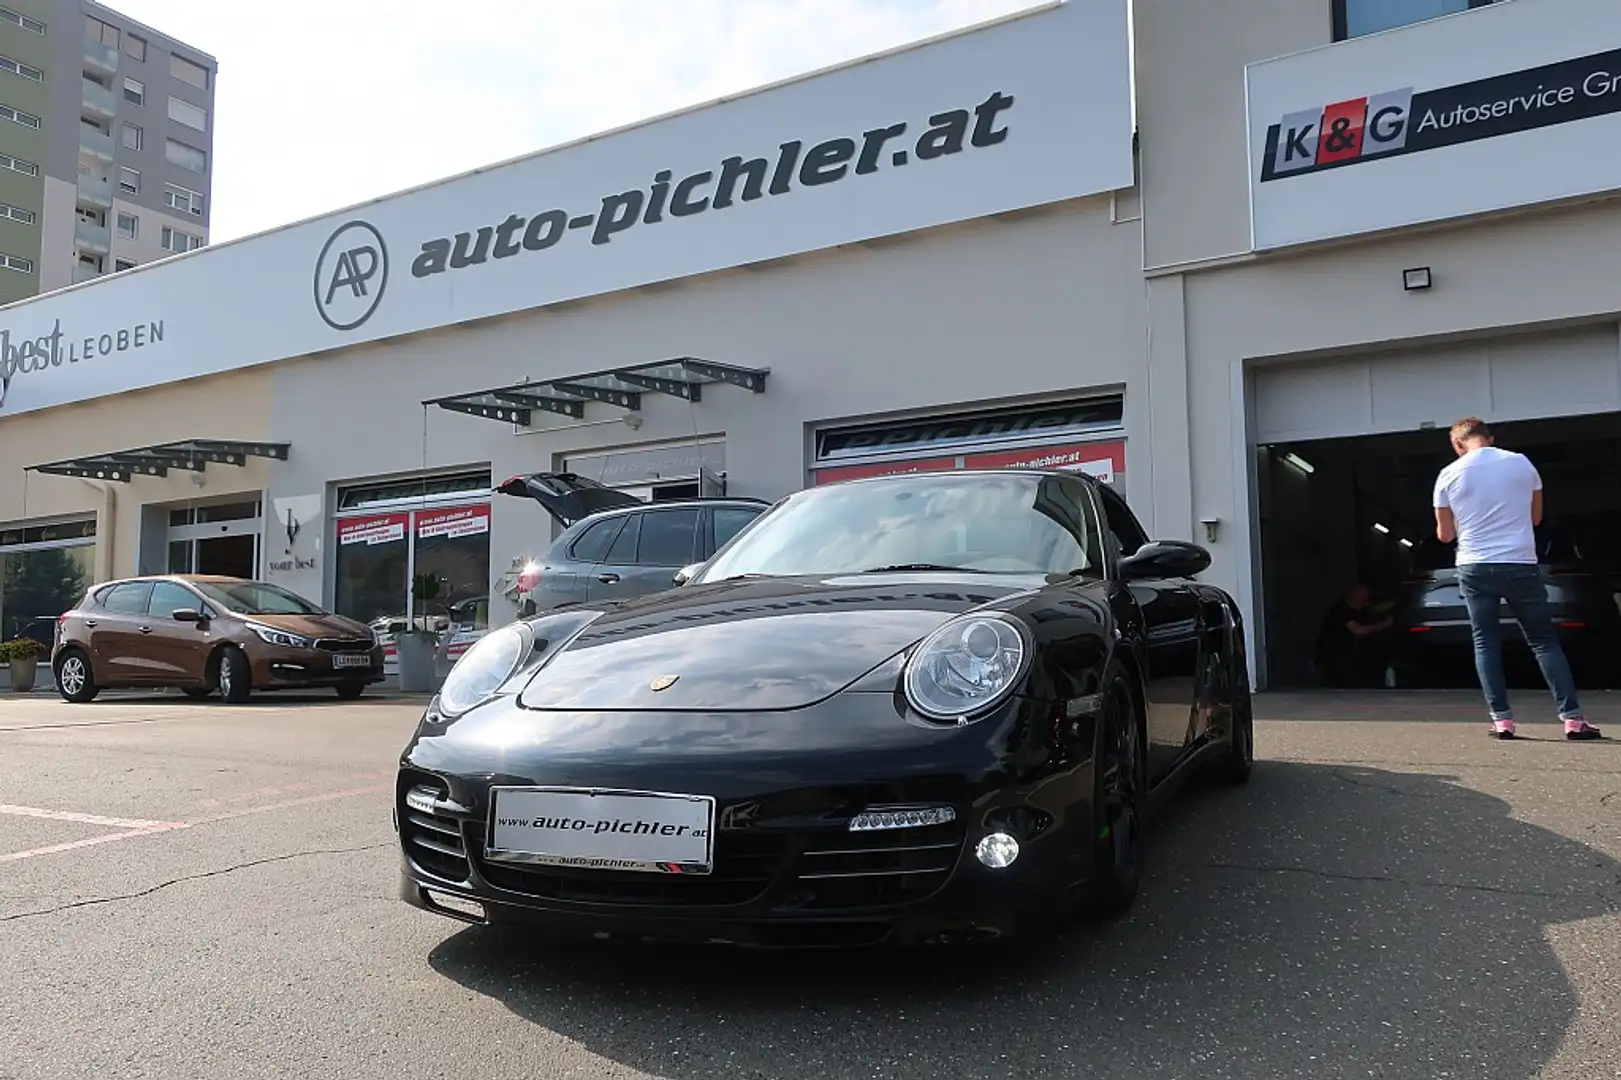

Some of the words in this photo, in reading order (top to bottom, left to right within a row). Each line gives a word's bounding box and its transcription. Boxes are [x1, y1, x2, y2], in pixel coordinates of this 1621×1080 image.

[1416, 84, 1575, 133] Autoservice
[411, 90, 1014, 279] auto-pichler.at
[69, 319, 164, 363] LEOBEN
